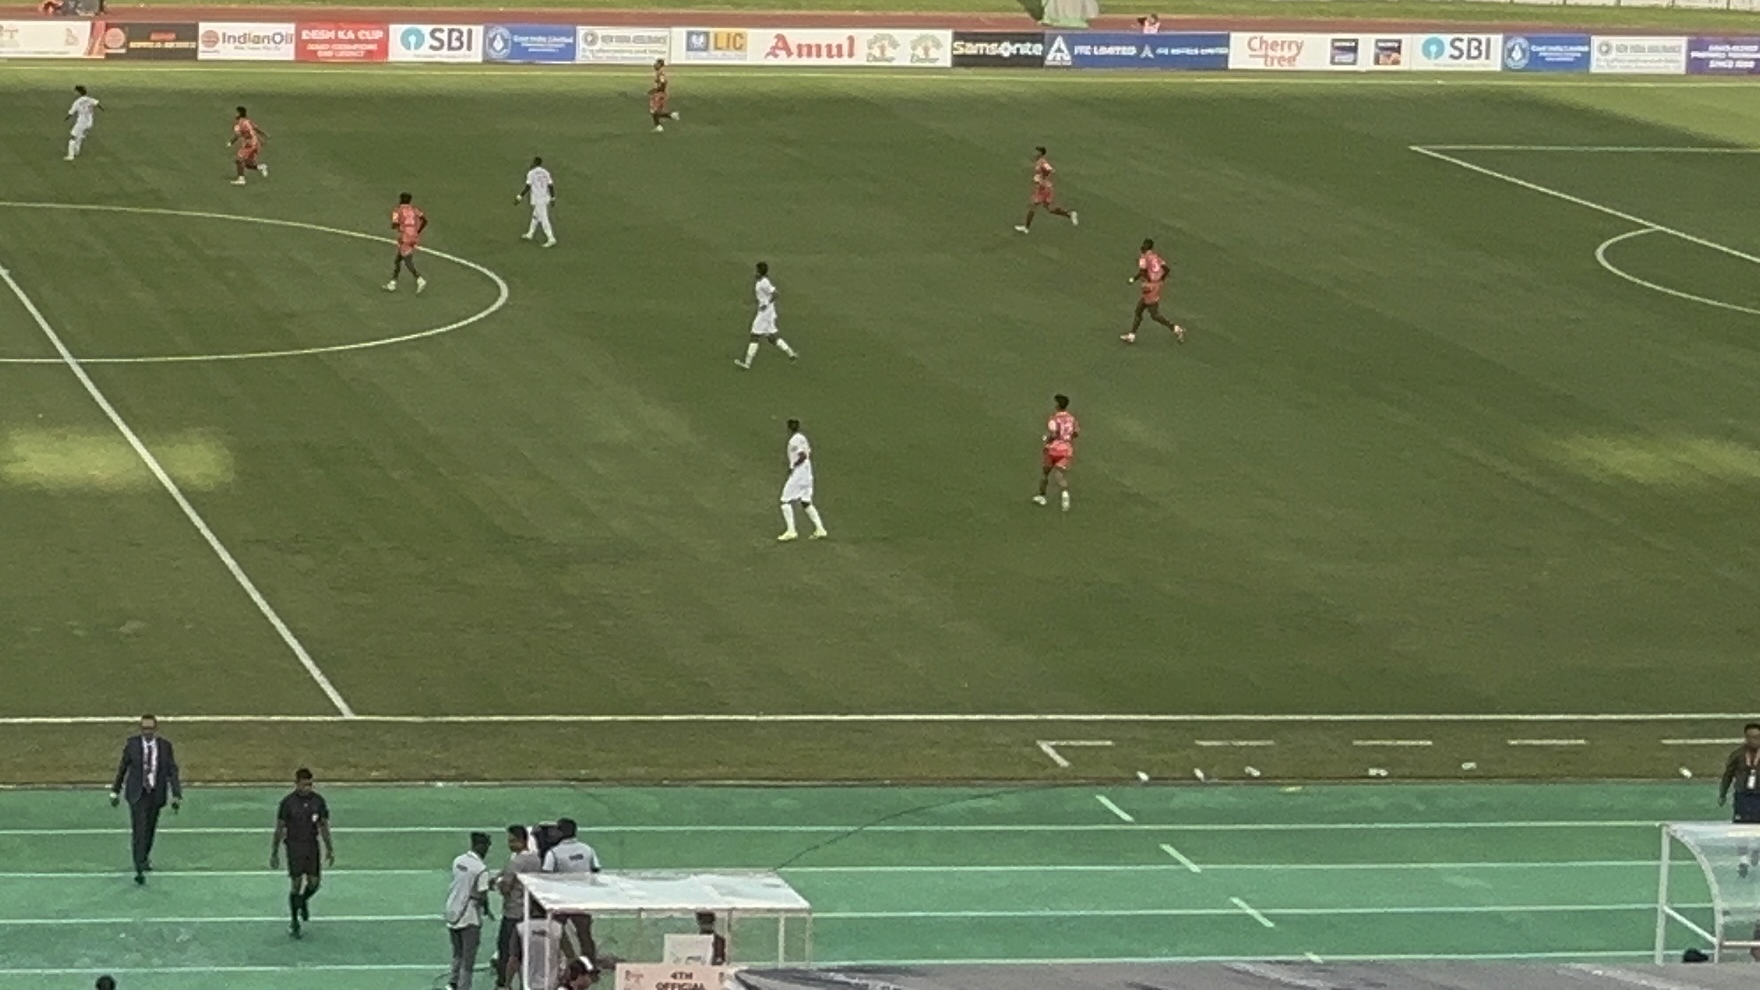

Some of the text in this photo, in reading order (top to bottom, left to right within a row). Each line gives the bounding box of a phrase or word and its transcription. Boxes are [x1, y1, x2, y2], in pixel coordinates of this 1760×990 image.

[222, 31, 293, 45] IndianOil
[357, 29, 384, 40] CUP
[428, 28, 473, 52] SBI
[713, 33, 744, 50] LIC
[765, 32, 856, 59] Amul
[953, 37, 1044, 57] Samsonite
[1093, 45, 1137, 55] LIMITED
[1248, 35, 1305, 56] Cherry
[1449, 36, 1492, 61] SBI
[1264, 52, 1296, 67] tree
[671, 972, 694, 980] 4TH
